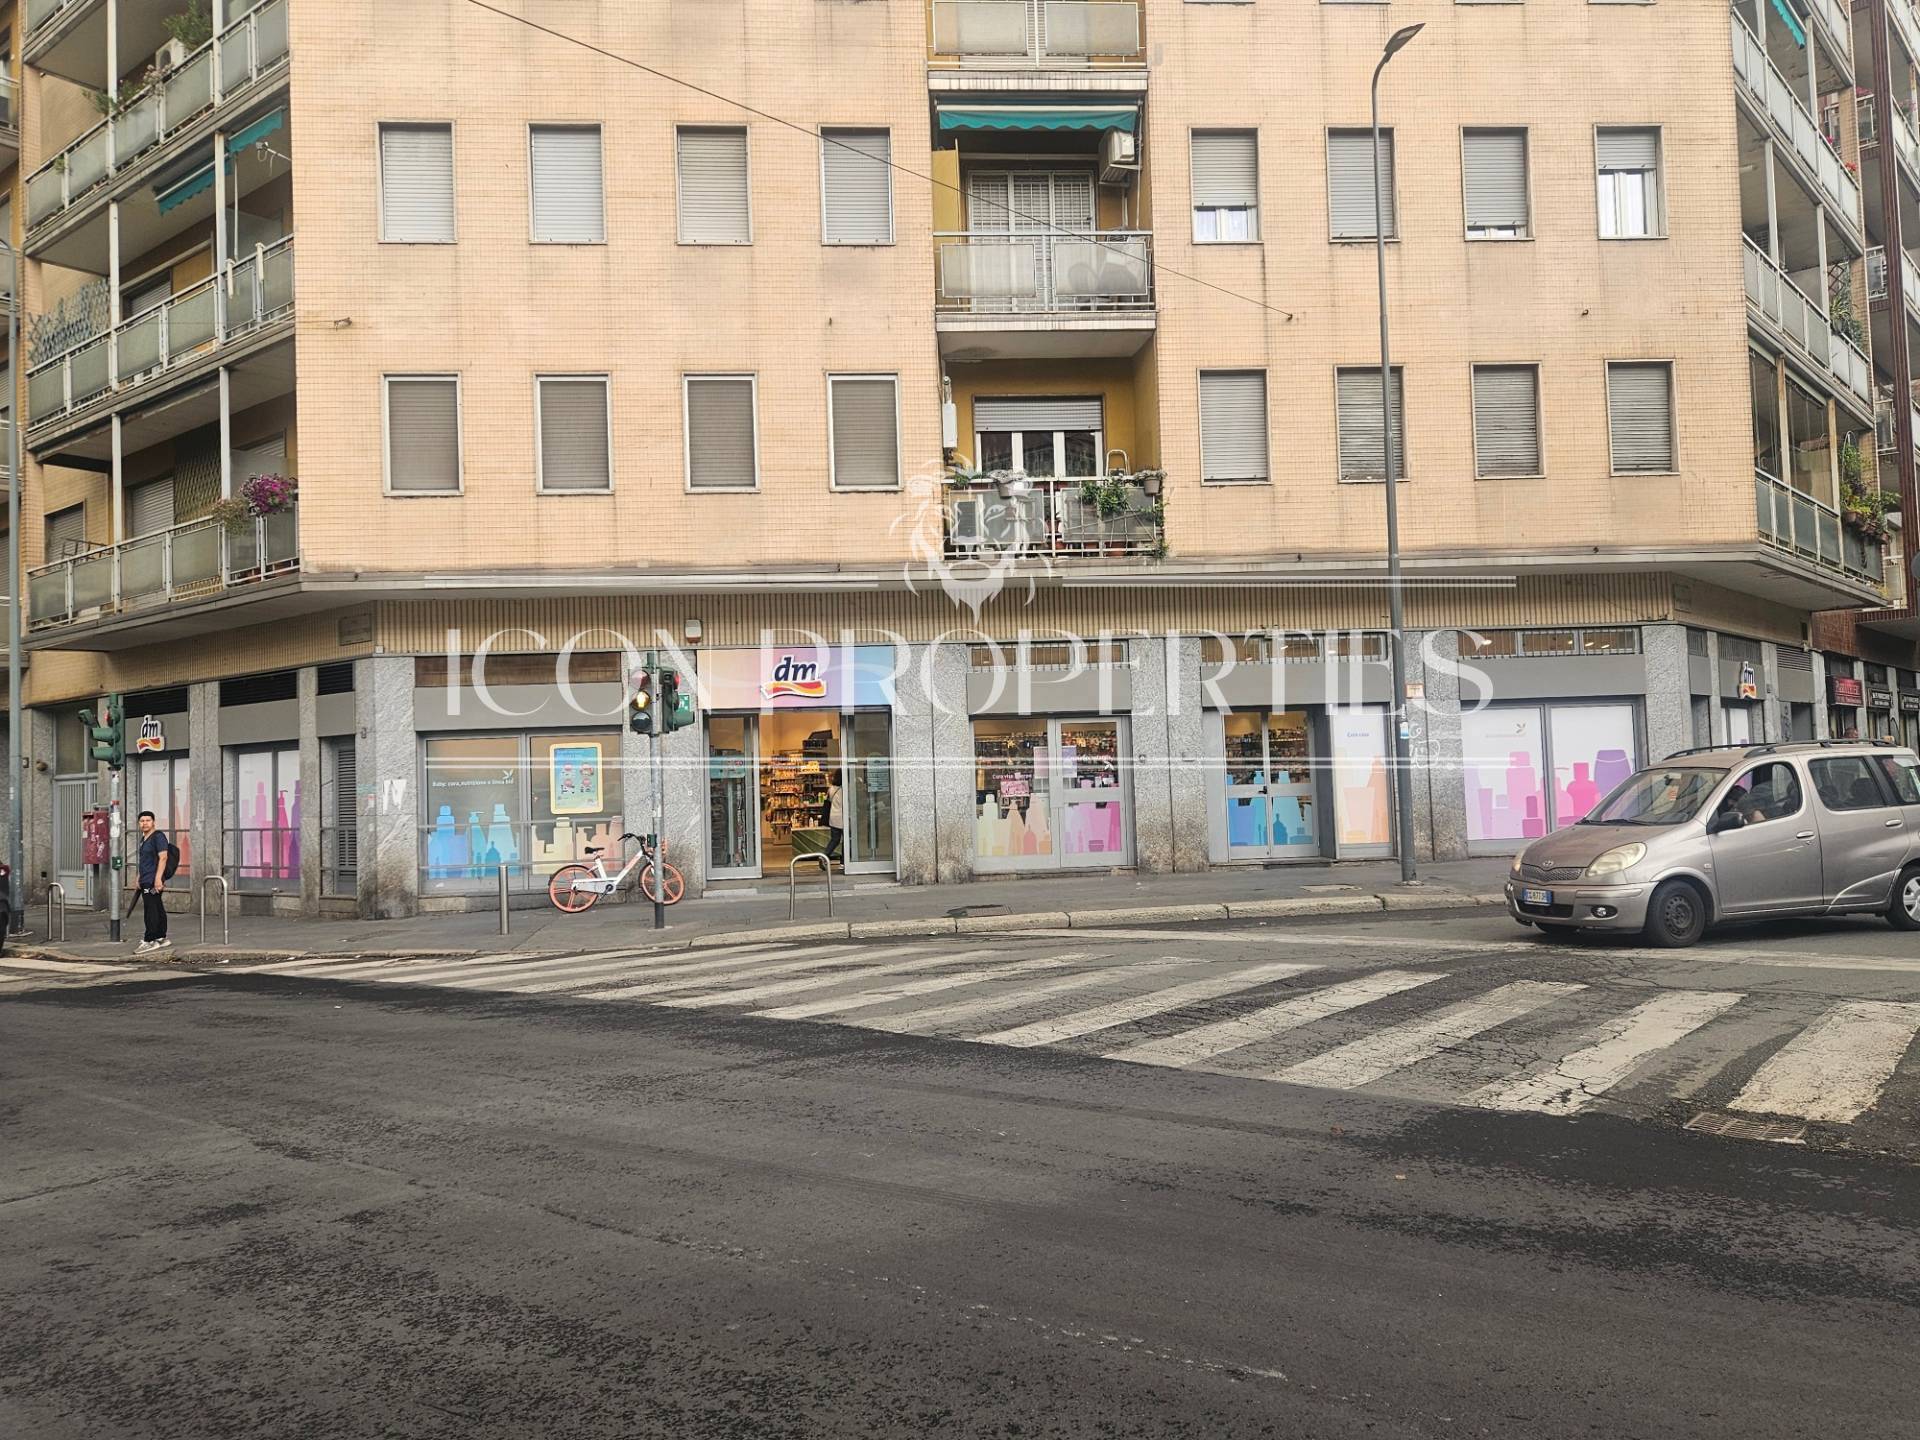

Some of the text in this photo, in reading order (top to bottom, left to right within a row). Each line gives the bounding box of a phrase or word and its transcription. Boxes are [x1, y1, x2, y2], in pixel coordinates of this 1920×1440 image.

[774, 656, 817, 682] dm
[1744, 663, 1754, 685] dm
[142, 717, 159, 739] dm
